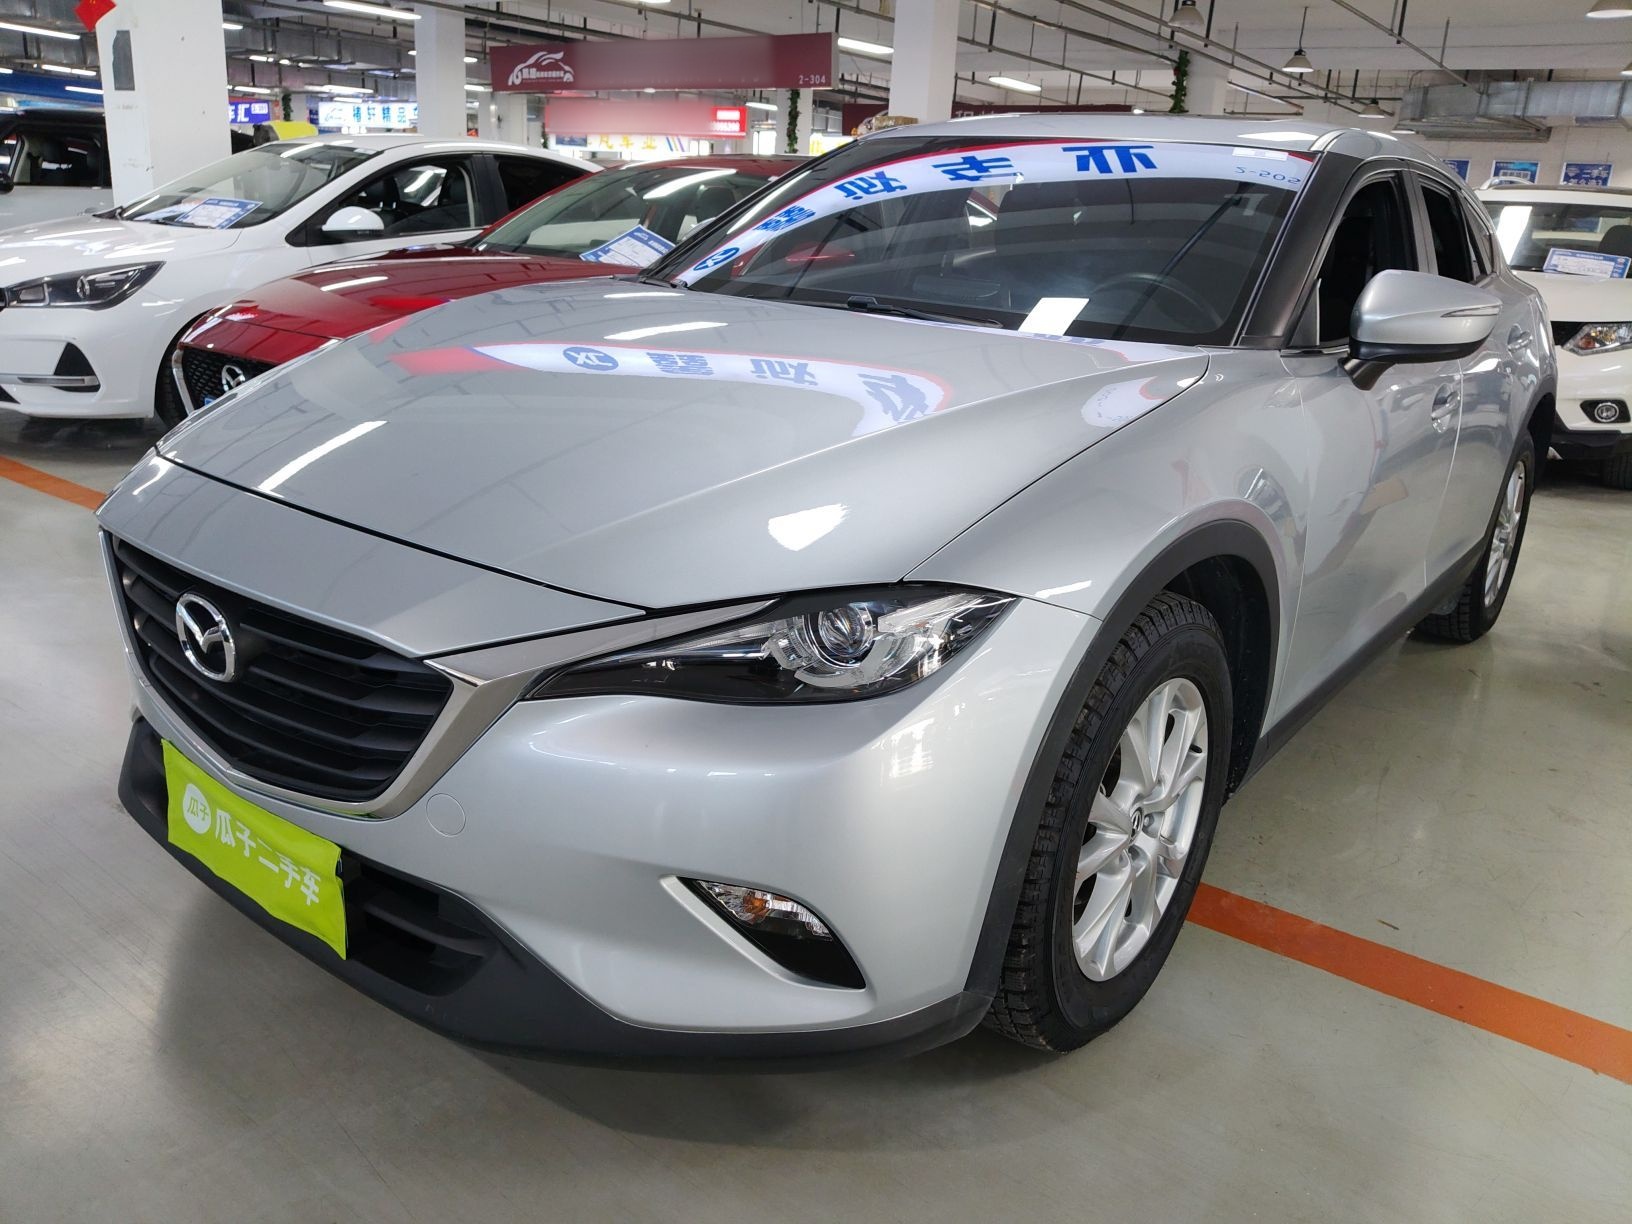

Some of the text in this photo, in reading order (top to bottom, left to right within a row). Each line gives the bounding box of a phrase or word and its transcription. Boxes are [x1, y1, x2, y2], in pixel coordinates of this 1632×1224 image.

[798, 74, 826, 85] 2-304
[187, 797, 209, 821] 瓜子
[215, 808, 322, 907] 瓜子二手车
